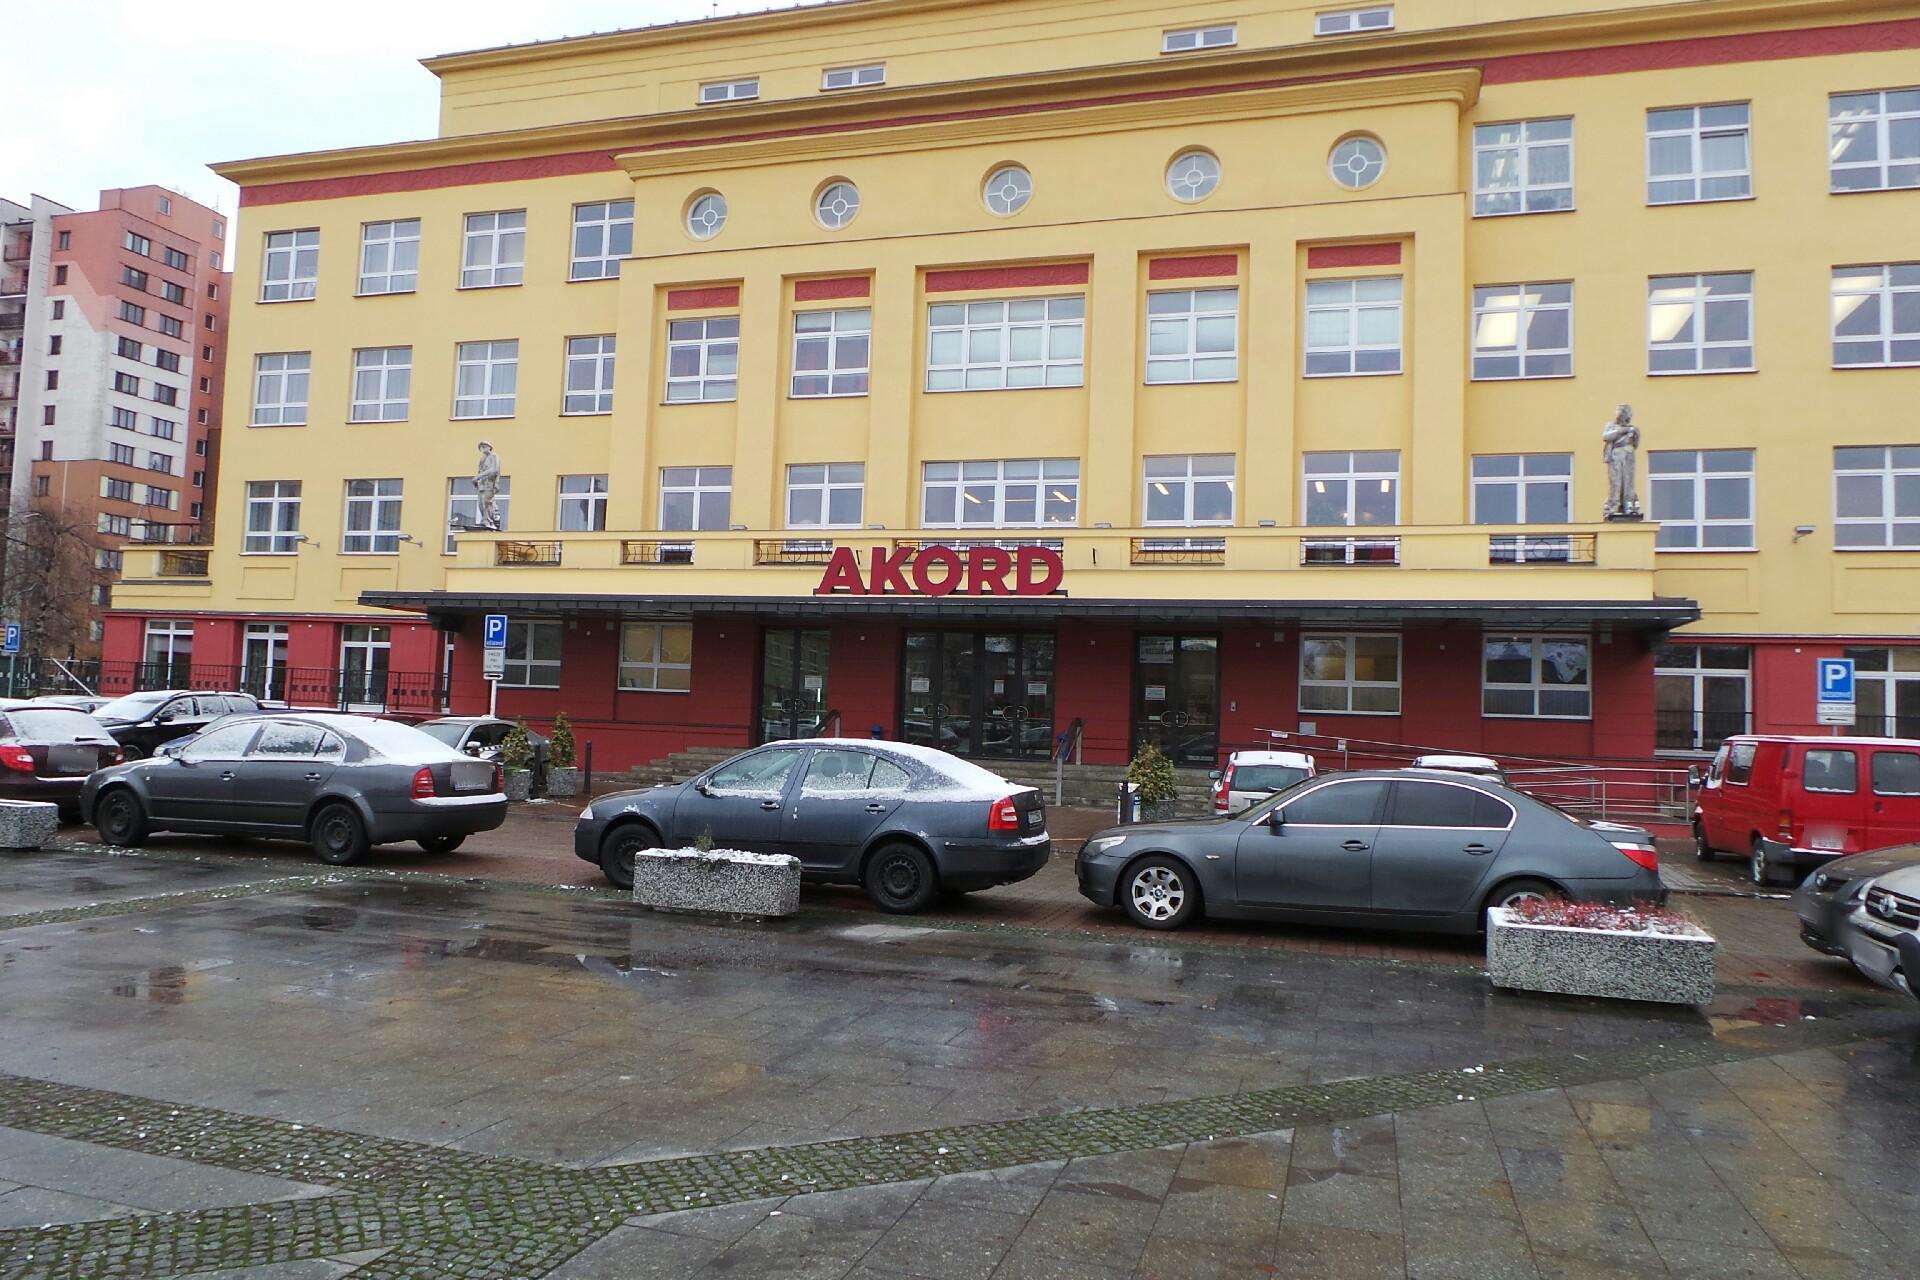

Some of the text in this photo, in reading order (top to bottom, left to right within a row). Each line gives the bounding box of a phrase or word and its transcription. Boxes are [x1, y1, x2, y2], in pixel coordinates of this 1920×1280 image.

[817, 545, 1064, 596] AKORD
[8, 627, 17, 644] P
[489, 619, 502, 638] P
[1825, 664, 1847, 690] P
